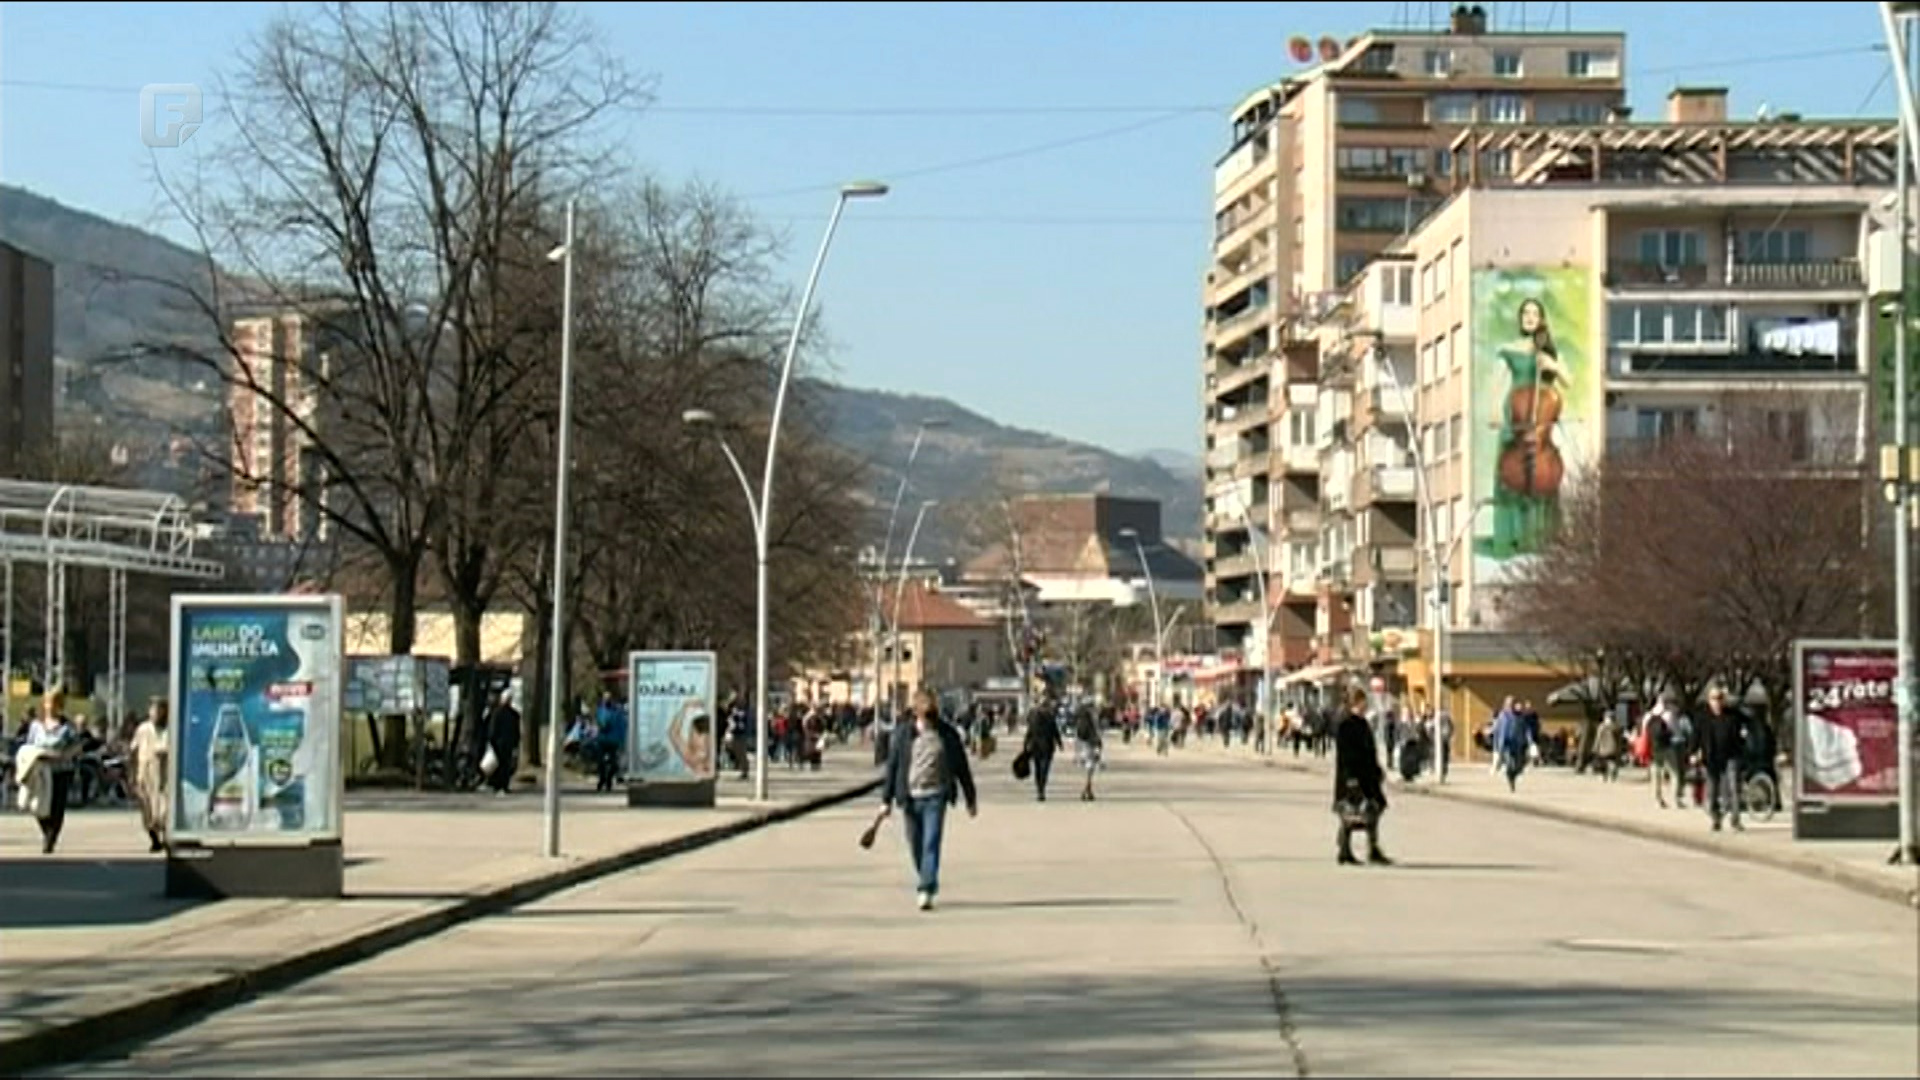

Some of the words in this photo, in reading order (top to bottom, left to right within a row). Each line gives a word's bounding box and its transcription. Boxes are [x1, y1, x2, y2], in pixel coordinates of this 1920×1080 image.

[239, 624, 264, 641] DO
[1808, 686, 1841, 710] 24
[1843, 679, 1889, 700] rate
